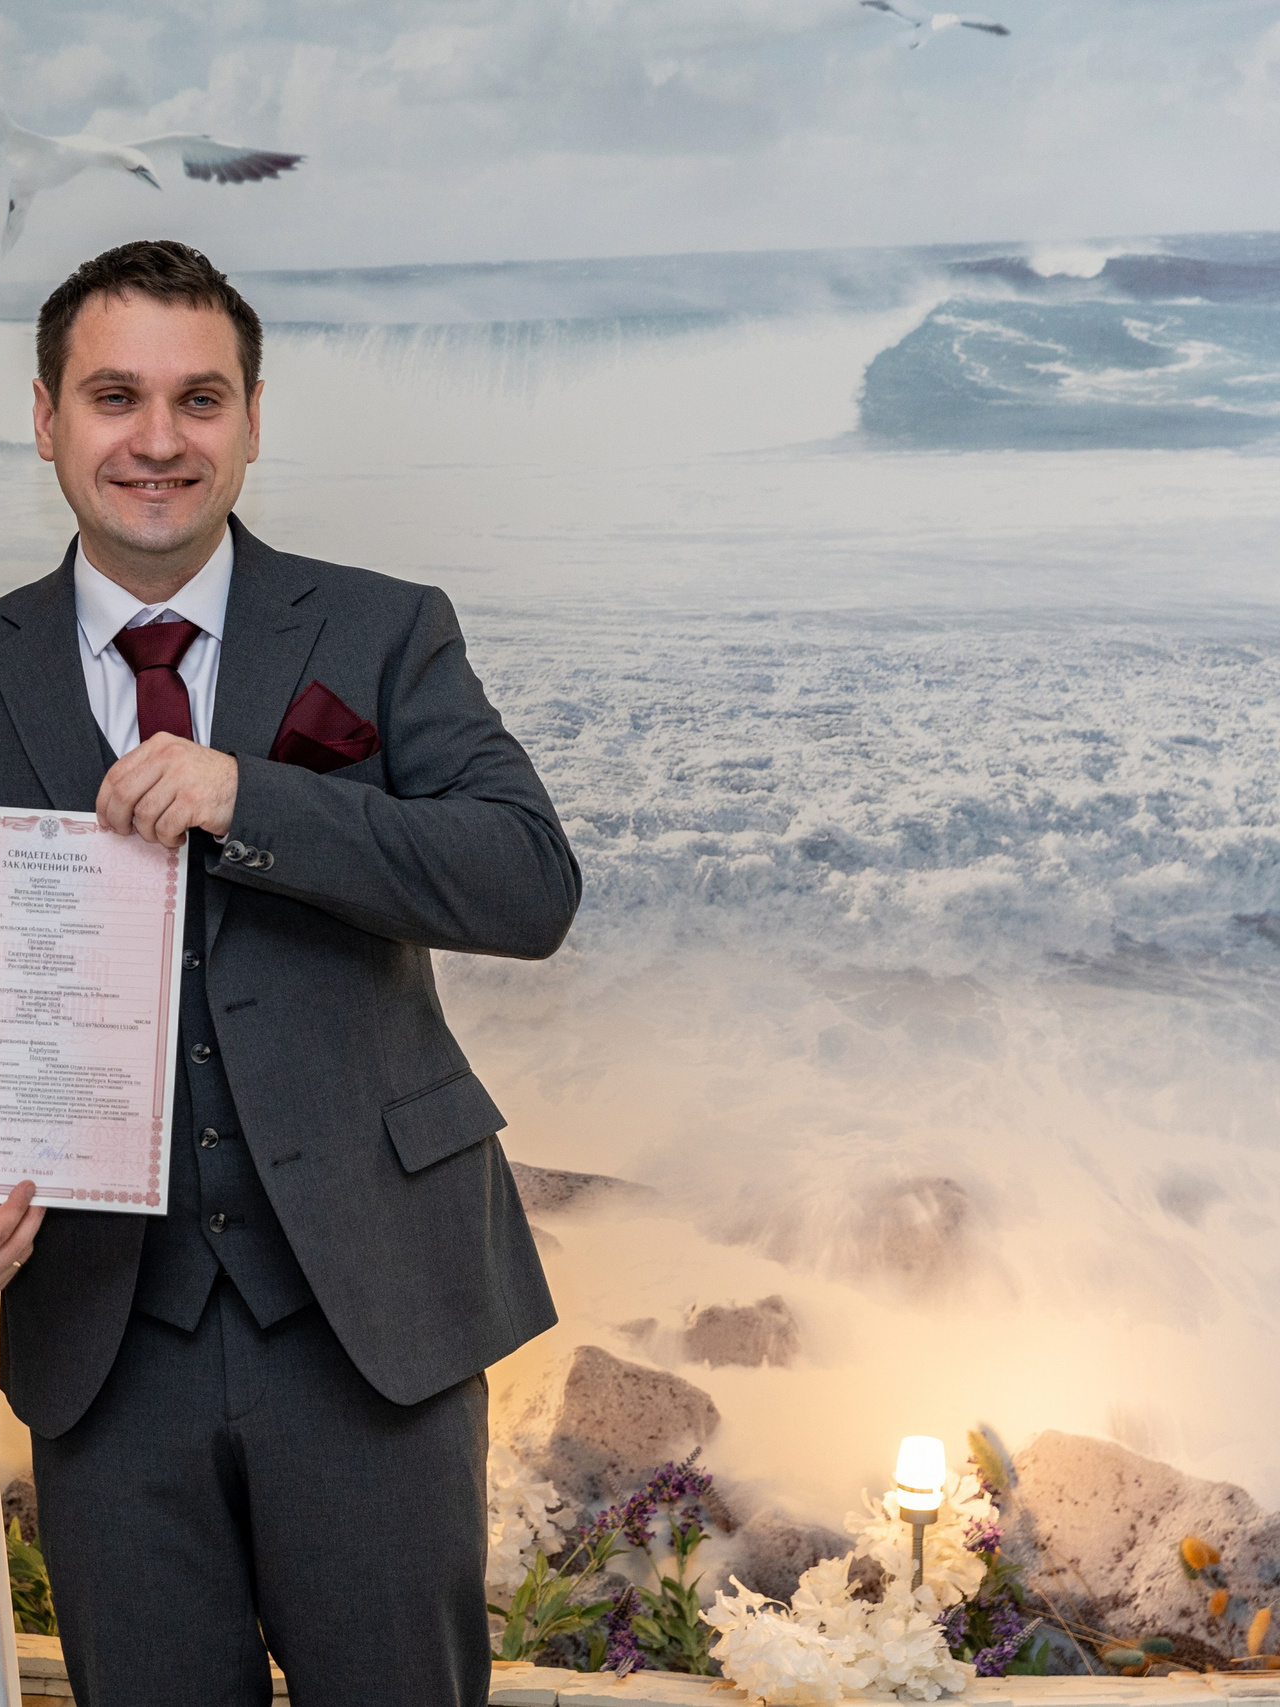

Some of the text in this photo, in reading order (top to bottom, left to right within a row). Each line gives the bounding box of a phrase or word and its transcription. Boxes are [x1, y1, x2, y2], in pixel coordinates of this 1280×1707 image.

[8, 849, 87, 862] СВИДЕТЕЛЬСТВО
[2, 860, 69, 872] ЗАКЛЮЧЕНИИ
[72, 865, 102, 874] БРАКА
